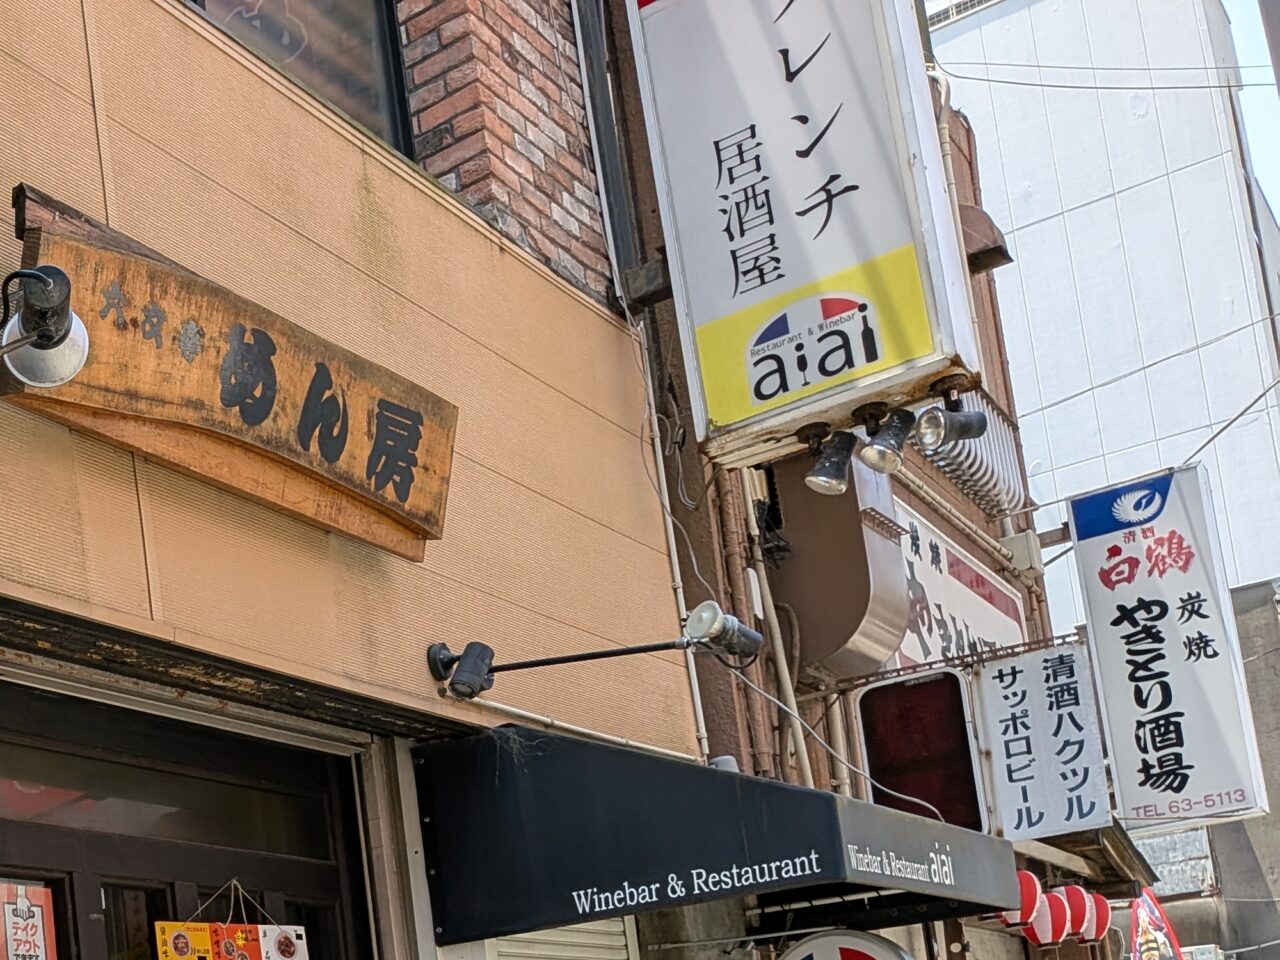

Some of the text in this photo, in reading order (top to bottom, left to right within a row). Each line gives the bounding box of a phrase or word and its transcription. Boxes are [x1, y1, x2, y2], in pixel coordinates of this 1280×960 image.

[773, 0, 860, 241] レンチ
[713, 123, 786, 299] 居酒屋
[750, 312, 857, 358] Restaurant & Winebar
[753, 303, 879, 401] aiai
[1098, 529, 1196, 592] 白鶴
[1176, 591, 1219, 663] 炭焼
[1110, 597, 1194, 793] やきとり酒場
[992, 665, 1045, 831] サッポロビール
[1041, 653, 1096, 822] 清酒ハクツル
[1131, 788, 1247, 819] TEL 63-5113
[572, 849, 821, 915] Winebar & Restaurant
[847, 841, 954, 886] Winebar & Restaurant aiai
[11, 921, 39, 938] テイク
[13, 938, 41, 954] アウト
